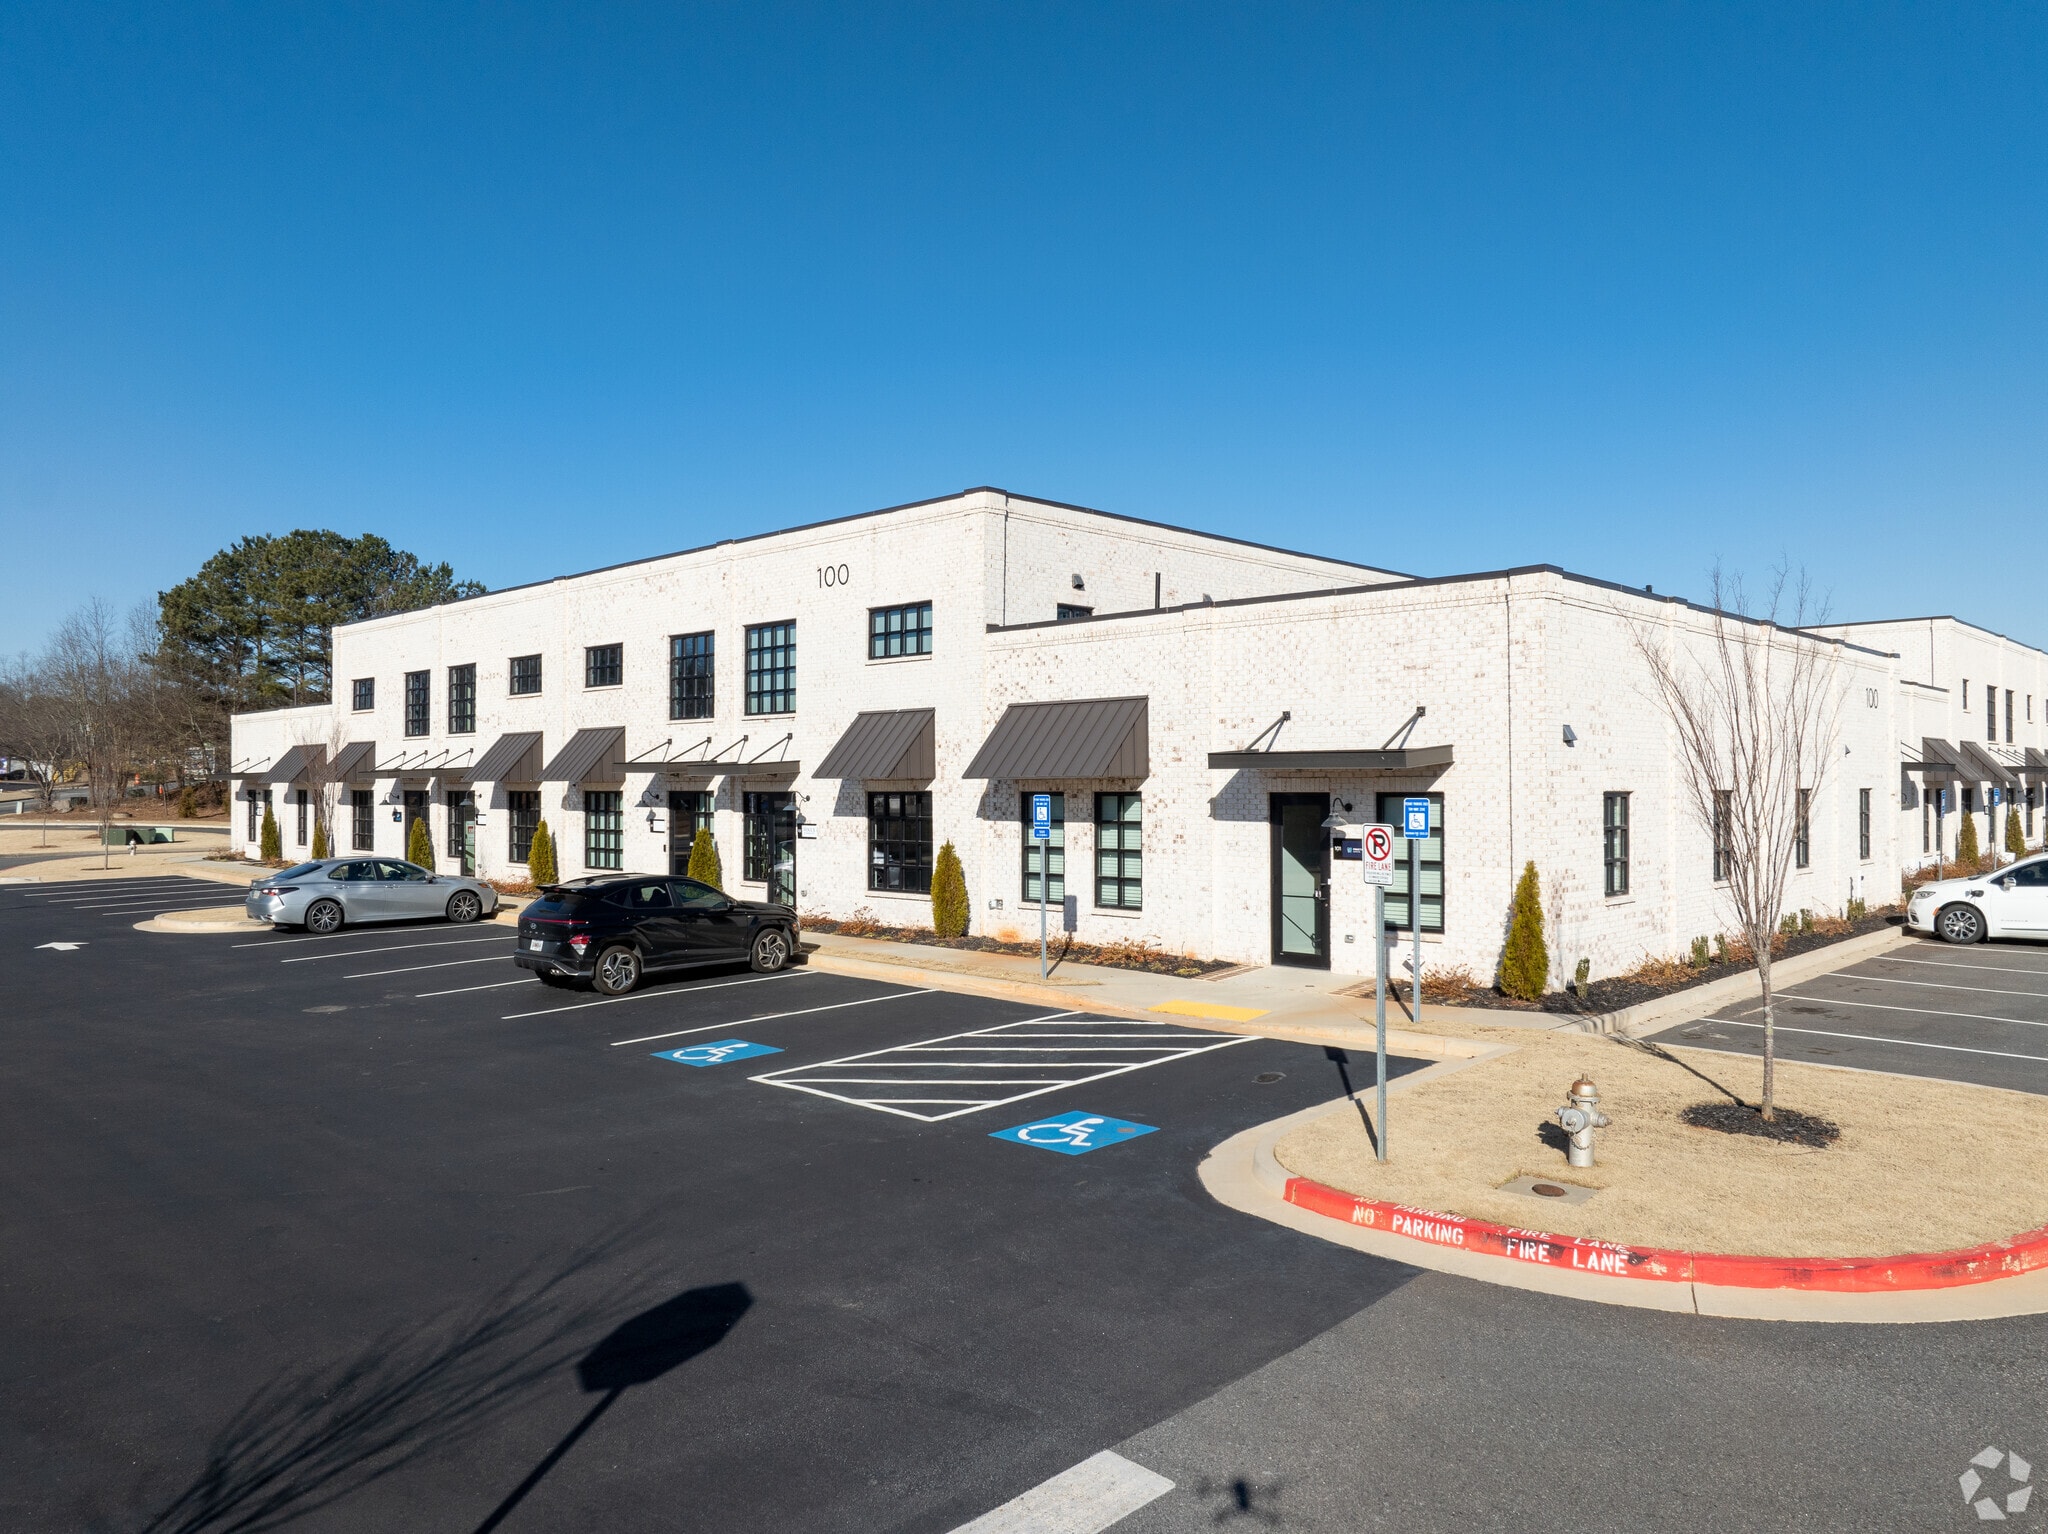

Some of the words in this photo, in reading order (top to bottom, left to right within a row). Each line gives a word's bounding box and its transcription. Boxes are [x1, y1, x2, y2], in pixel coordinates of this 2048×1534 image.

[817, 563, 849, 588] 100
[1865, 688, 1878, 709] 100
[1373, 834, 1386, 855] P
[1365, 861, 1377, 871] FIRE
[1378, 862, 1391, 872] LANE
[1354, 1196, 1380, 1206] NO
[1393, 1203, 1467, 1224] PARKING
[1507, 1227, 1554, 1240] FIRE
[1573, 1236, 1630, 1254] LANE
[1352, 1204, 1375, 1225] NO
[1392, 1214, 1464, 1245] PARKING
[1506, 1237, 1550, 1263] FIRE
[1572, 1248, 1629, 1275] LANE
